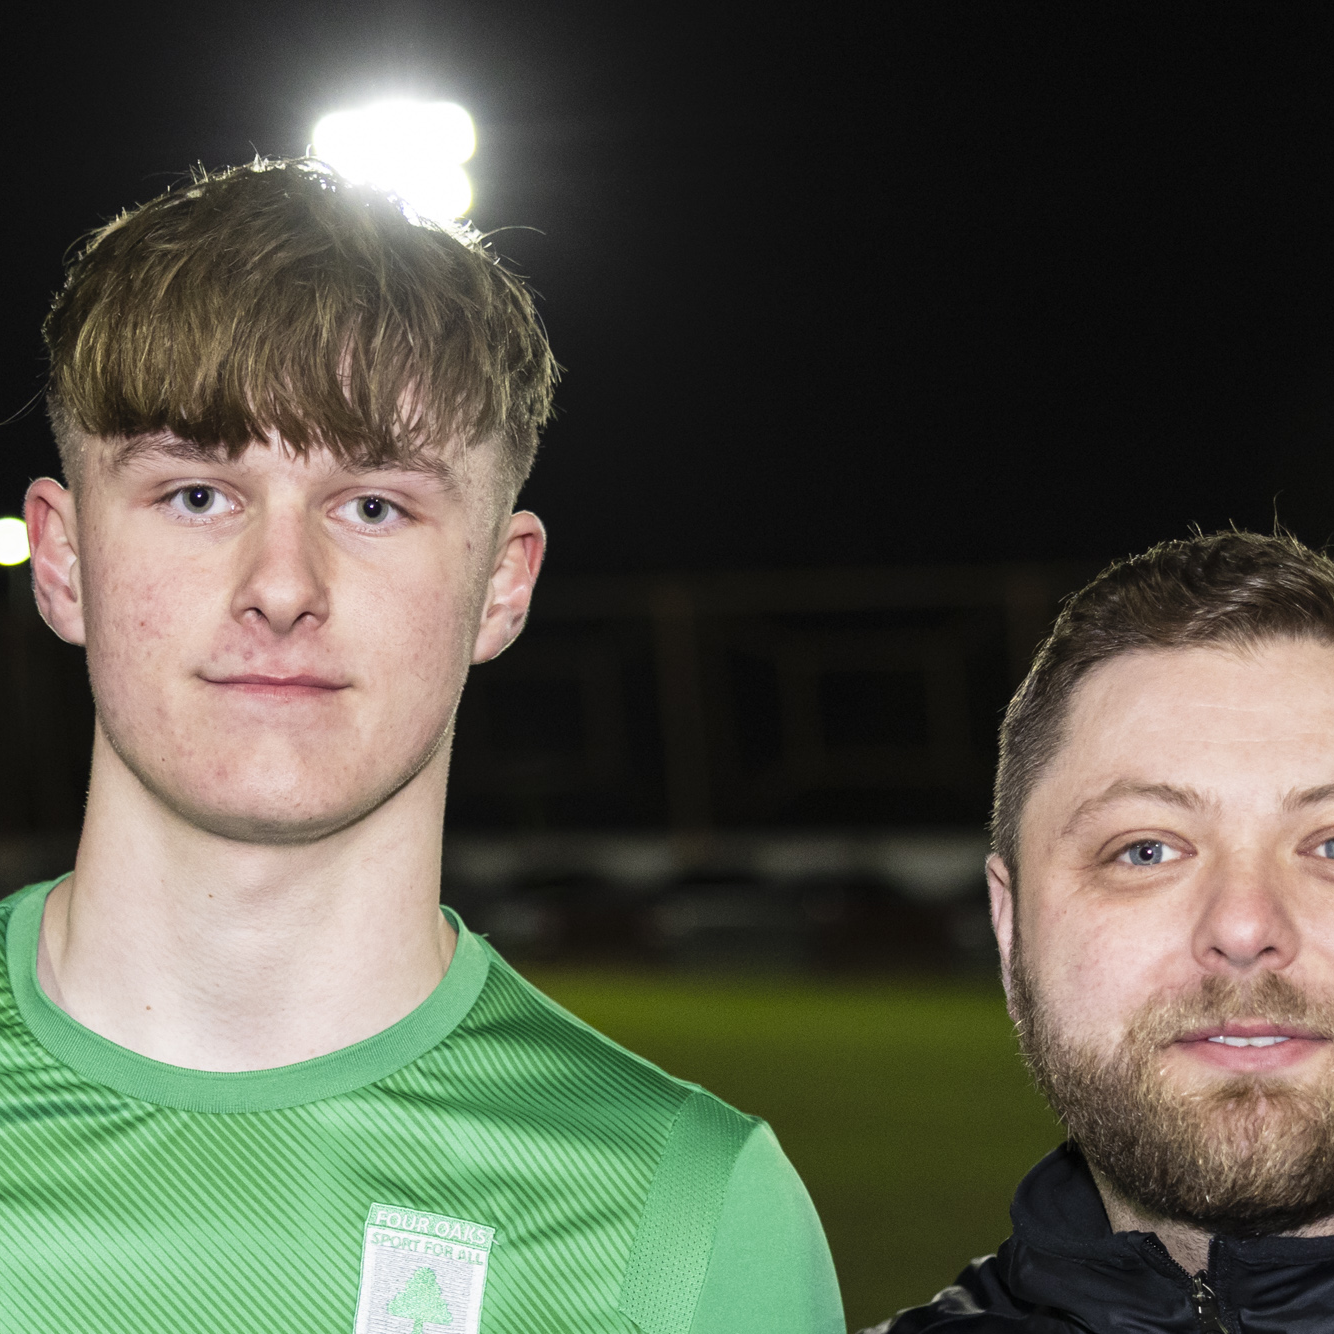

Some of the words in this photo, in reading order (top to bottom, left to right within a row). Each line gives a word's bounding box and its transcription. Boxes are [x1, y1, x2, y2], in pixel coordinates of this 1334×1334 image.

[375, 1210, 430, 1234] FOUR
[434, 1221, 487, 1245] OAKS
[371, 1231, 421, 1252] SPORT
[424, 1241, 454, 1258] FOR
